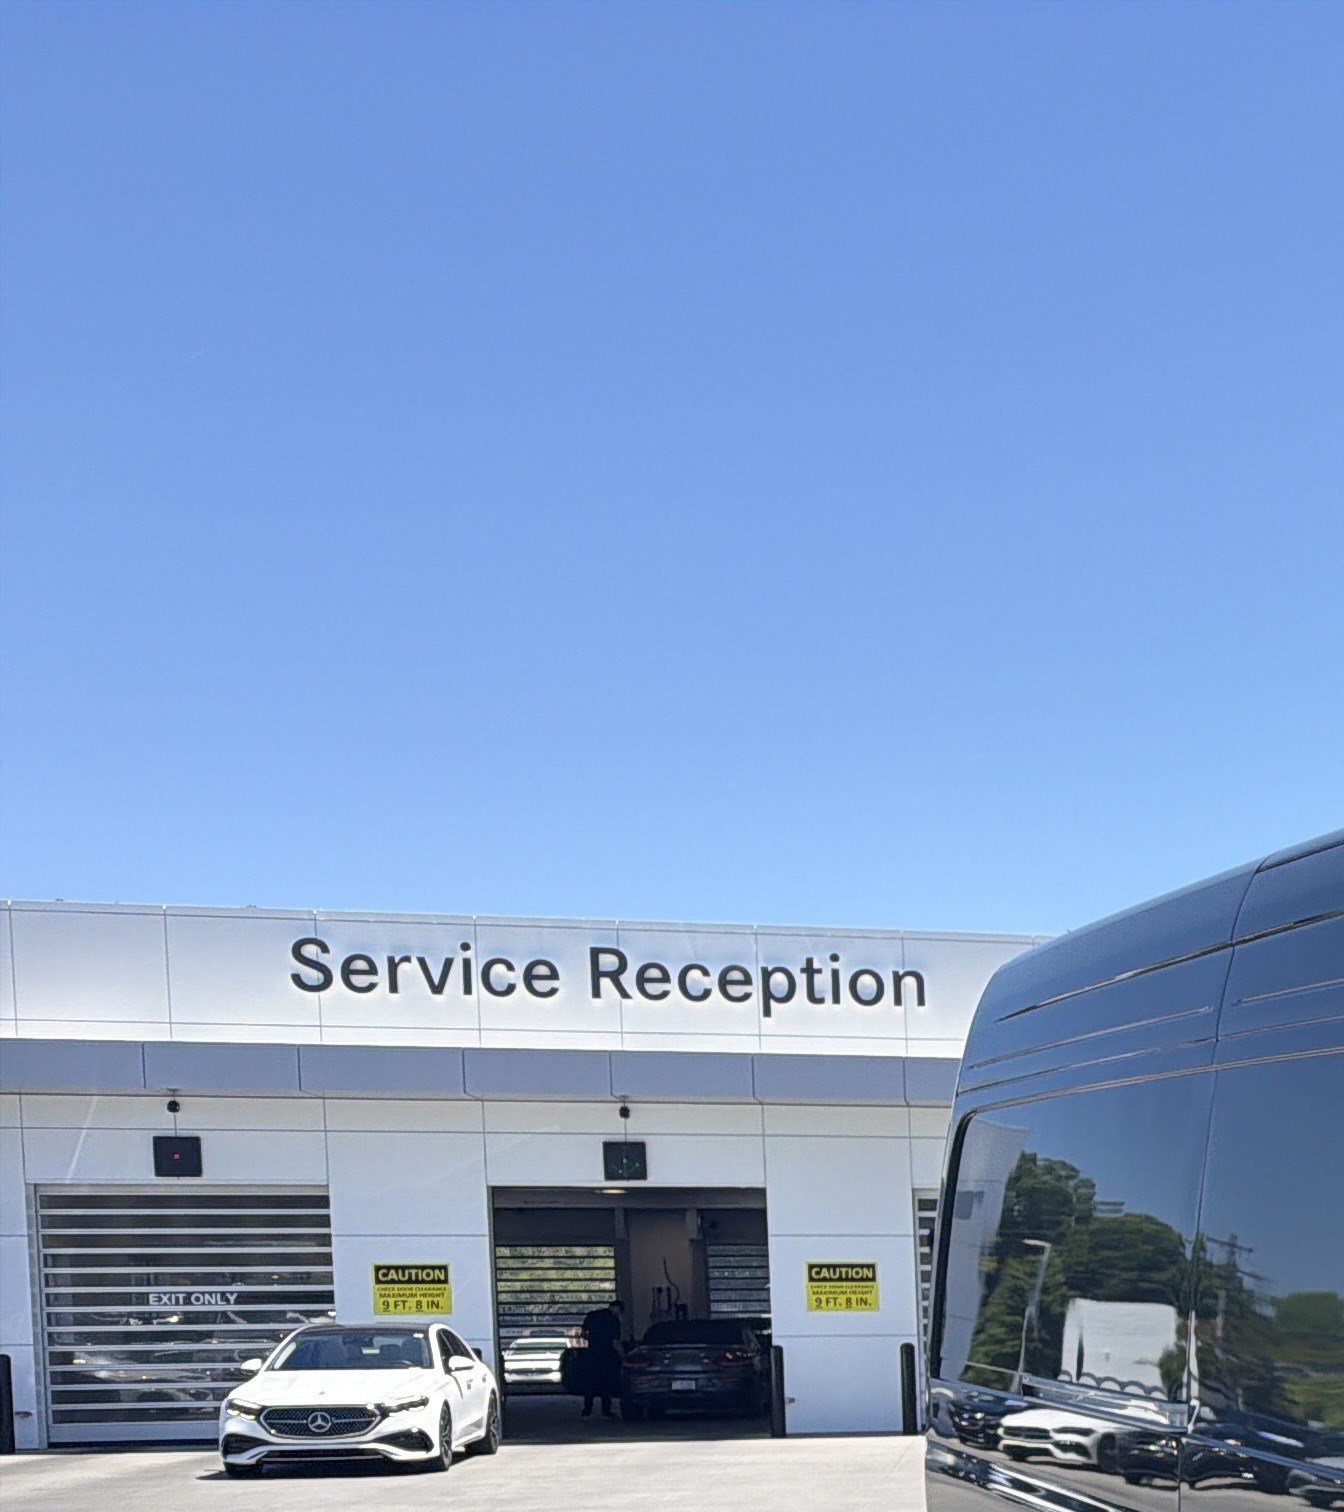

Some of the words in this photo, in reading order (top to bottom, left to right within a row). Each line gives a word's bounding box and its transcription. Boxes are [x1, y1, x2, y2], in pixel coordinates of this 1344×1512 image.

[290, 936, 560, 1000] Service
[589, 945, 926, 1018] Reception
[378, 1268, 446, 1281] CAUTION
[811, 1267, 873, 1279] CAUTION
[148, 1292, 187, 1305] EXIT
[190, 1292, 238, 1305] ONLY
[382, 1299, 390, 1310] 9
[394, 1299, 412, 1310] FT.
[415, 1299, 423, 1310] 8
[426, 1299, 443, 1310] IN.
[814, 1297, 823, 1307] 9
[825, 1297, 842, 1308] FT.
[845, 1297, 853, 1307] 8
[855, 1297, 872, 1307] IN.
